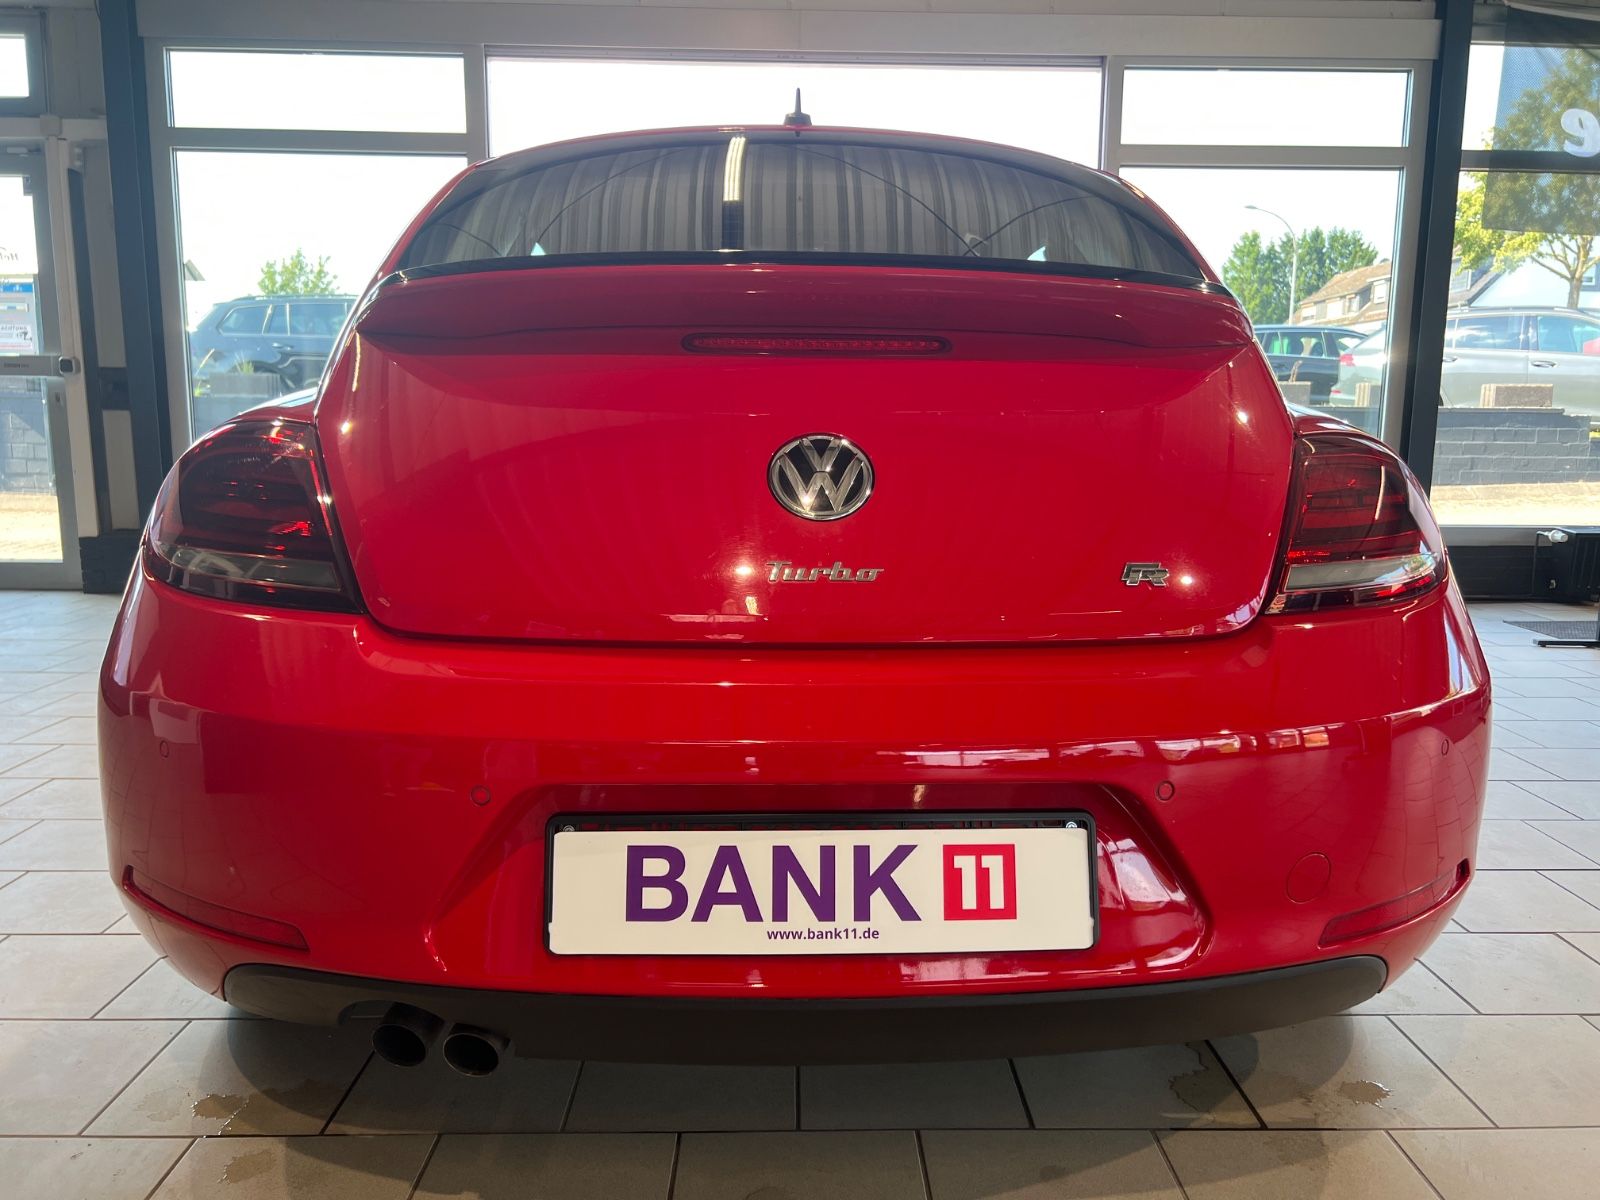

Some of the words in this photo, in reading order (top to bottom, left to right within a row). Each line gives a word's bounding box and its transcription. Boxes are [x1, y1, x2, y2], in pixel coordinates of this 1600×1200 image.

[767, 432, 875, 522] VW
[766, 561, 884, 584] Turbo
[625, 844, 921, 923] BANK
[953, 855, 1005, 910] 11
[766, 927, 880, 942] www.bank11.de
